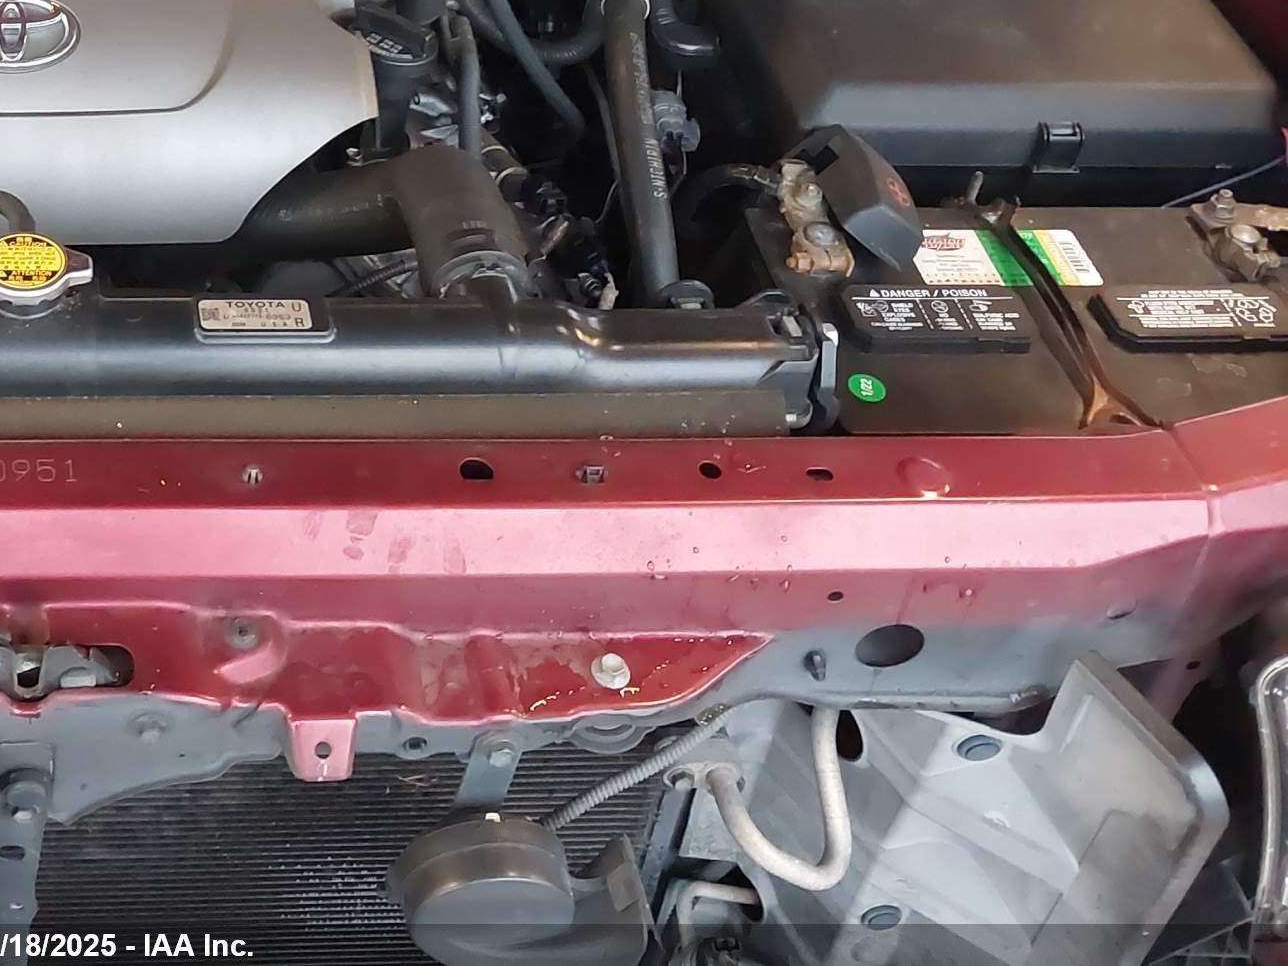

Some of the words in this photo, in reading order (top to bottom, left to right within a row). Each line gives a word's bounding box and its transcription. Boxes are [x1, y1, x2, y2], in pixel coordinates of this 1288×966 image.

[880, 289, 930, 298] DANGER
[942, 289, 988, 298] POISON
[225, 301, 285, 309] TOYOTA
